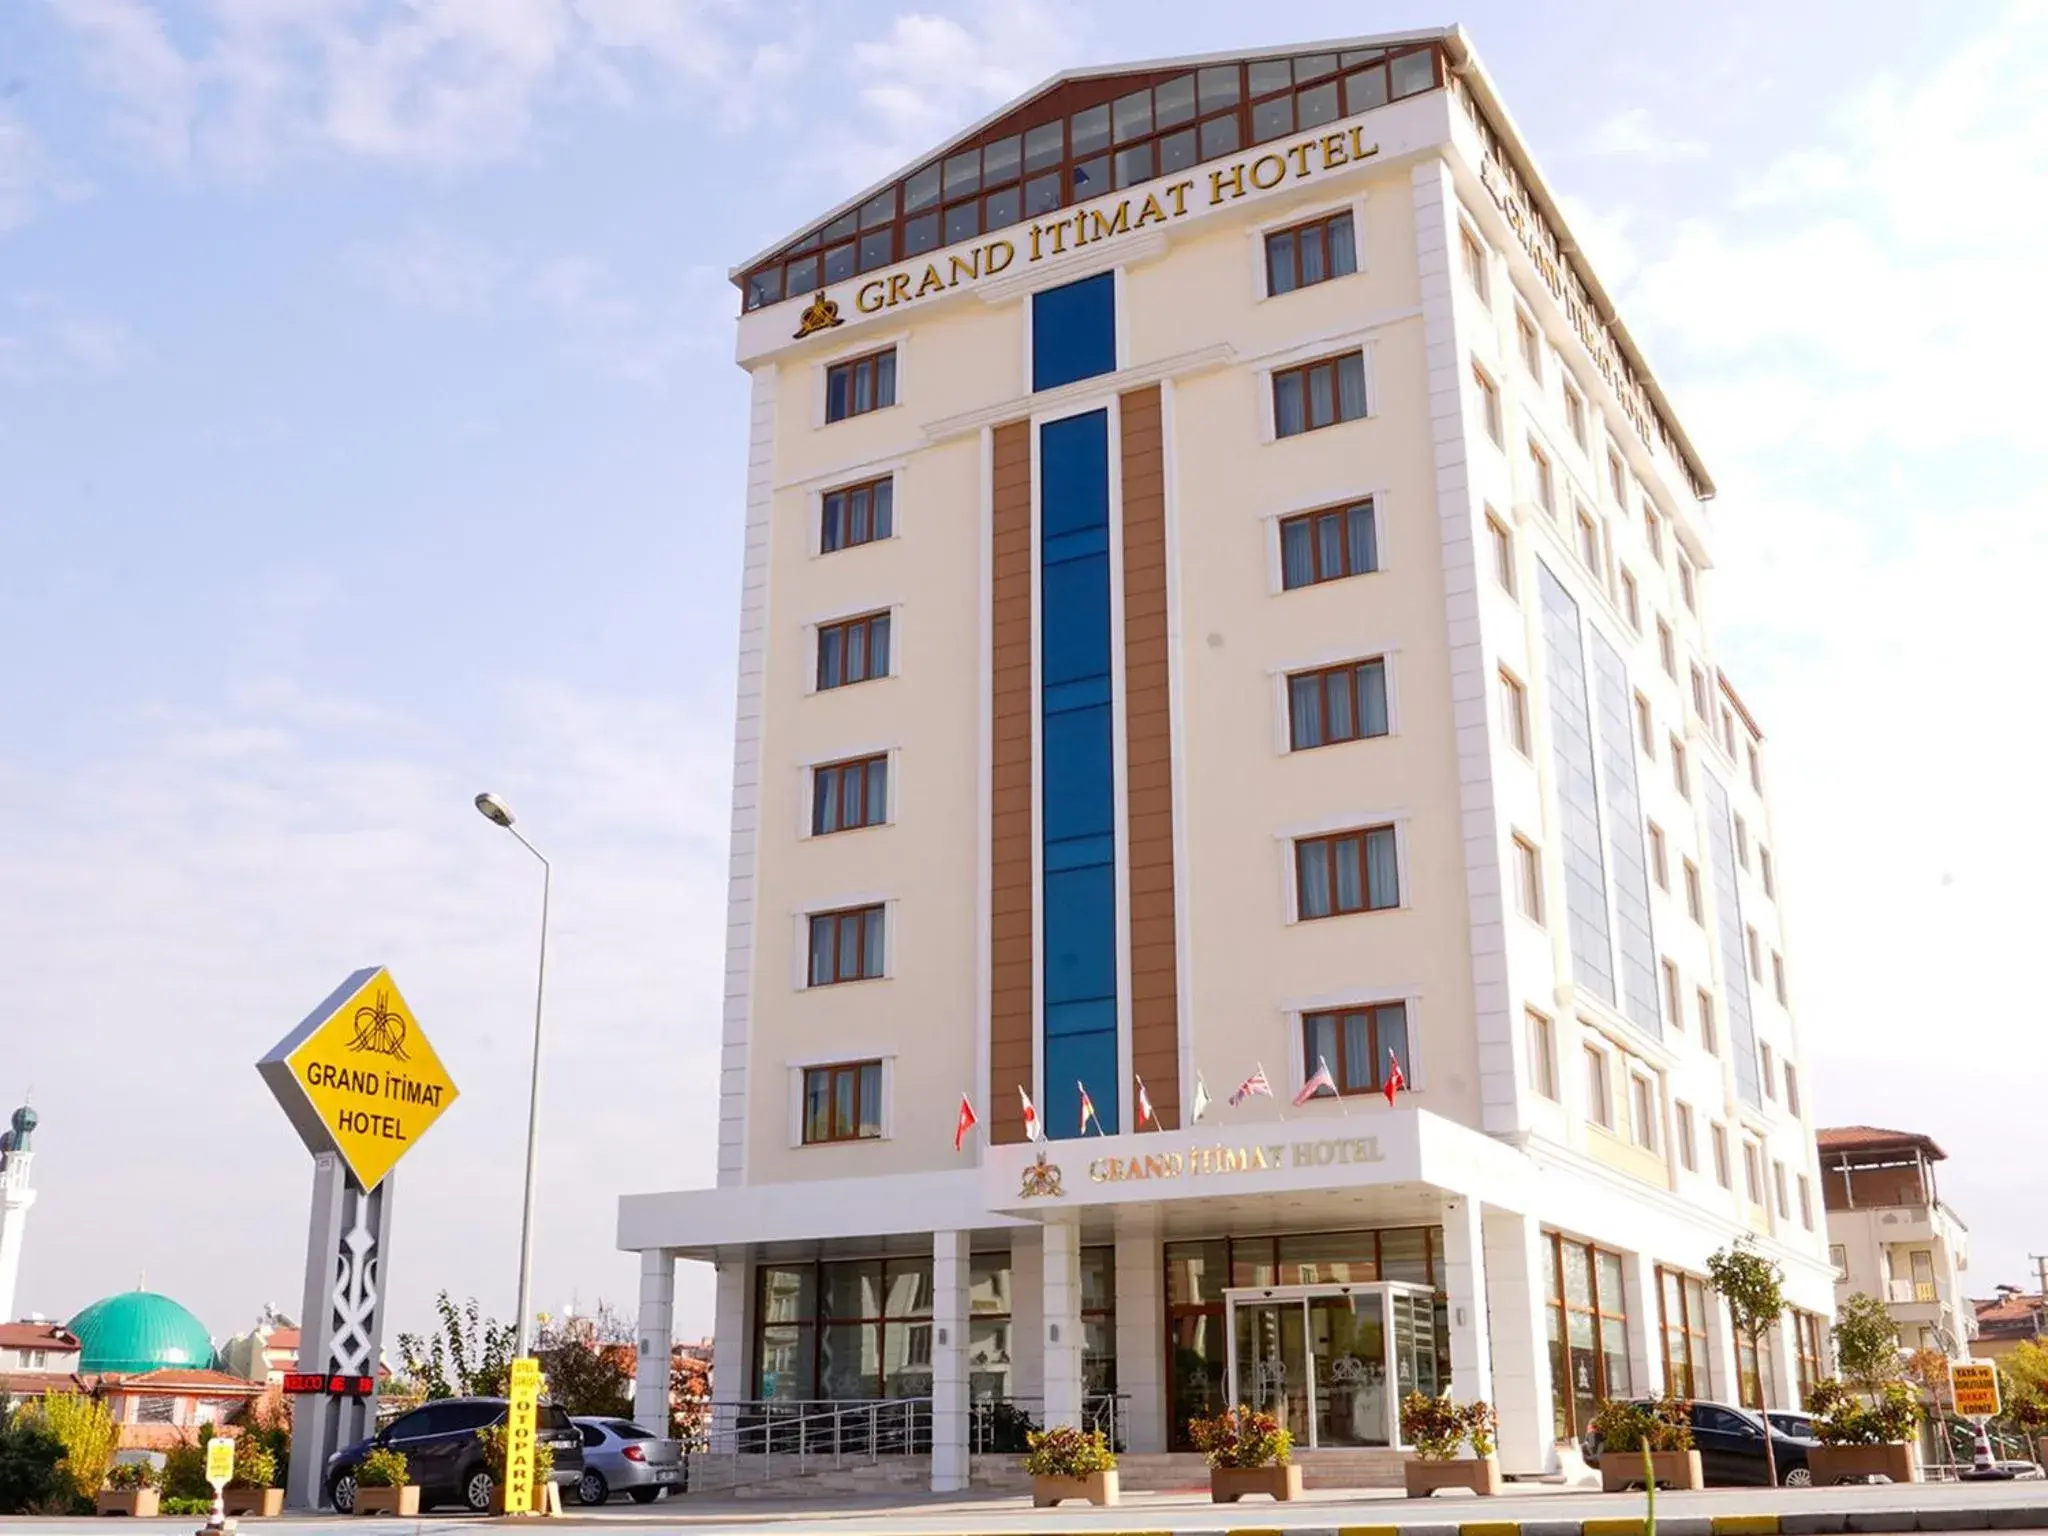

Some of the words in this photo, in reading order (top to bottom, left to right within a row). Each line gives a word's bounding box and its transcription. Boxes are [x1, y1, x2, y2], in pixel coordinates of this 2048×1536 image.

[855, 239, 1015, 314] GRAND
[1028, 178, 1194, 262] İTİMAT
[1208, 125, 1379, 206] HOTEL
[307, 1062, 378, 1096] GRAND
[384, 1070, 443, 1107] İTİMAT
[338, 1109, 407, 1141] HOTEL
[1090, 1152, 1184, 1183] GRAND
[1290, 1135, 1385, 1168] HOTEL
[513, 1400, 530, 1506] OTOPARKI
